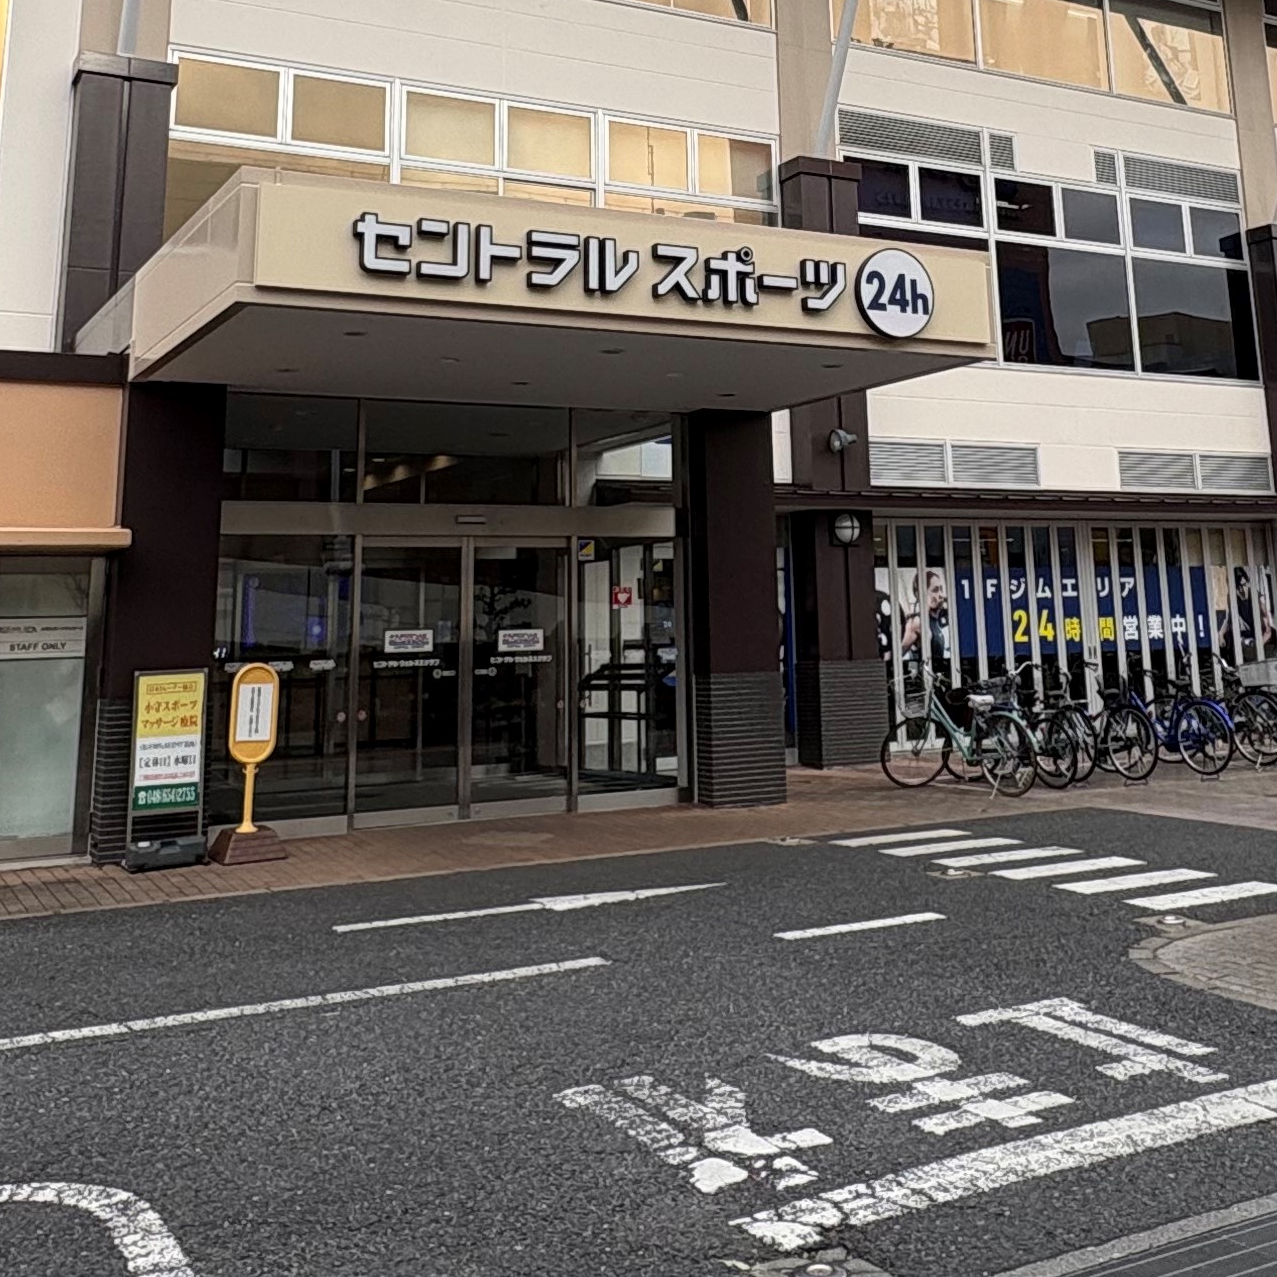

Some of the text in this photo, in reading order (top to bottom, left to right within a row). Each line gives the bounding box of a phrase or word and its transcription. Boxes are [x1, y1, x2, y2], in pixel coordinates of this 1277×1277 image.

[865, 269, 930, 317] 24h
[9, 641, 67, 652] STAFF ONLY
[553, 997, 1230, 1196] 止まれ
